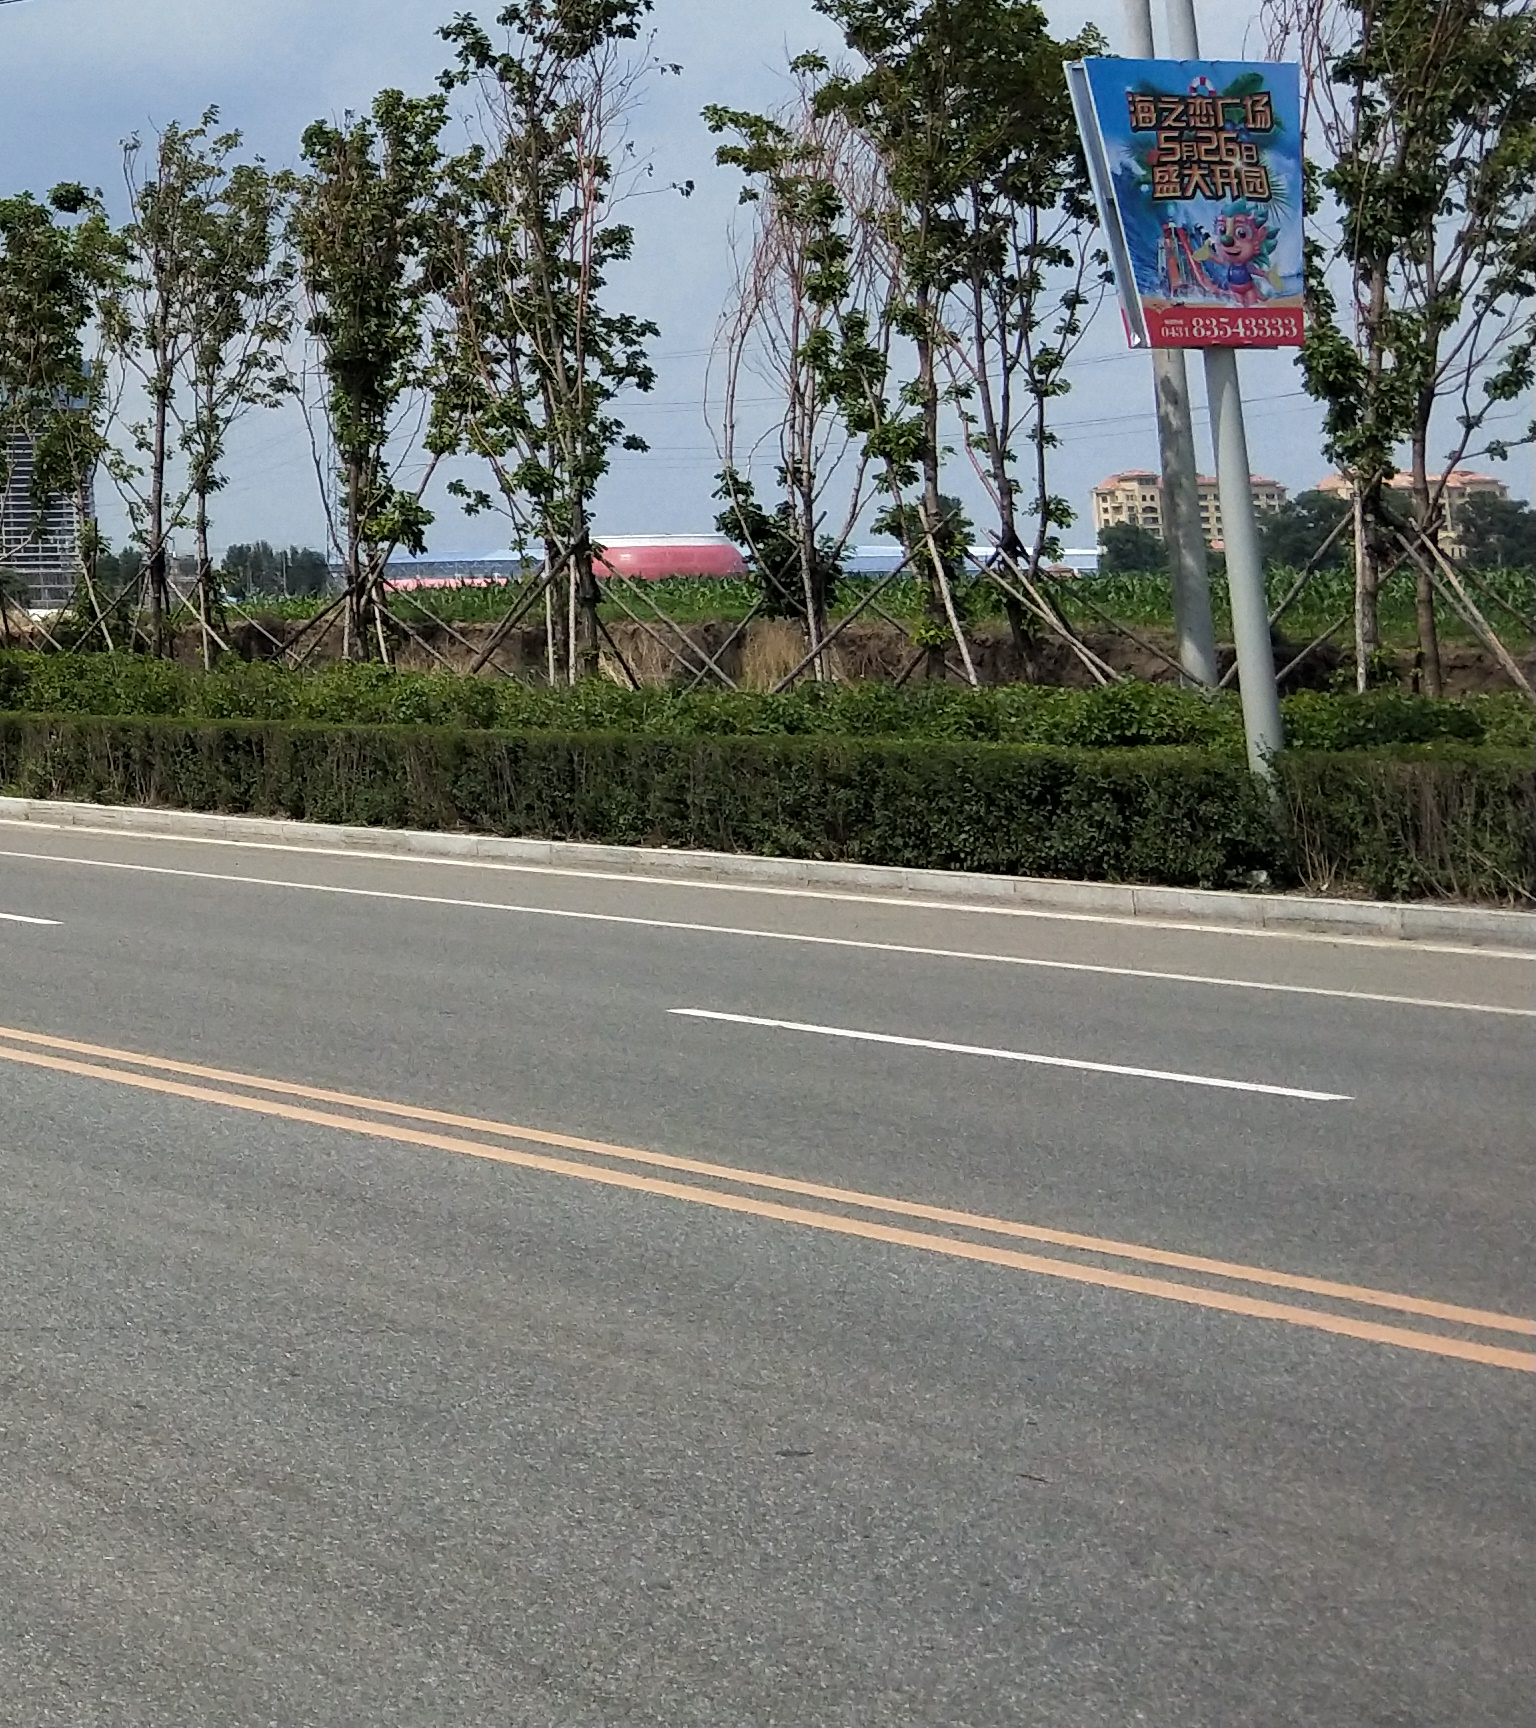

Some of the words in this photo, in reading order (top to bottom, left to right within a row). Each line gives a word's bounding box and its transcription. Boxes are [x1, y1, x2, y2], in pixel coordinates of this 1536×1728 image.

[1129, 93, 1273, 130] 海之恋广场
[1157, 131, 1259, 163] 5月26日
[1152, 165, 1270, 200] 盛大开园
[1160, 325, 1190, 339] 0431
[1191, 317, 1298, 339] 83543333
